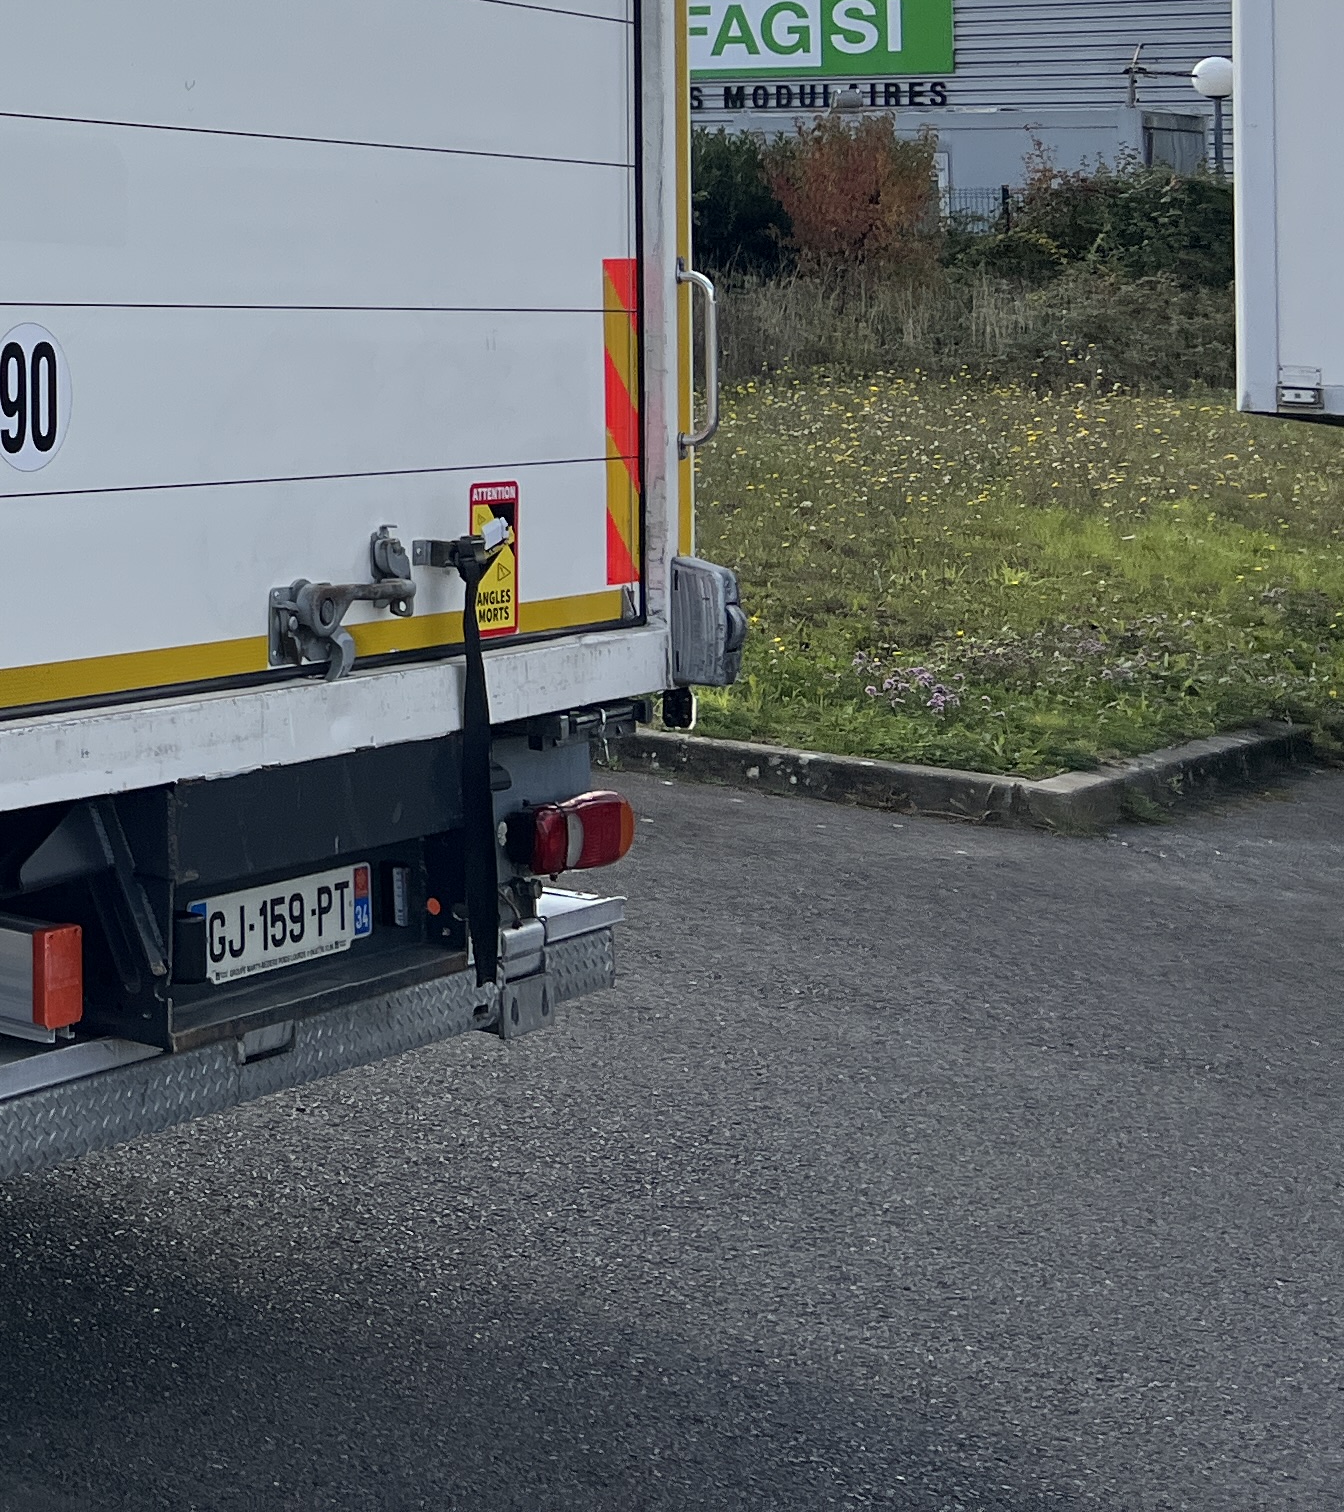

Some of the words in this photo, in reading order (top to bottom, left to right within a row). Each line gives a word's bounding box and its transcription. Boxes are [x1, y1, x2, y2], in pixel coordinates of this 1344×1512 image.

[723, 81, 948, 109] MODULIRES
[0, 341, 58, 454] 90
[472, 485, 516, 501] ATTENTION
[476, 588, 511, 606] ANGLES
[478, 606, 510, 623] MORTS
[355, 904, 369, 930] 34
